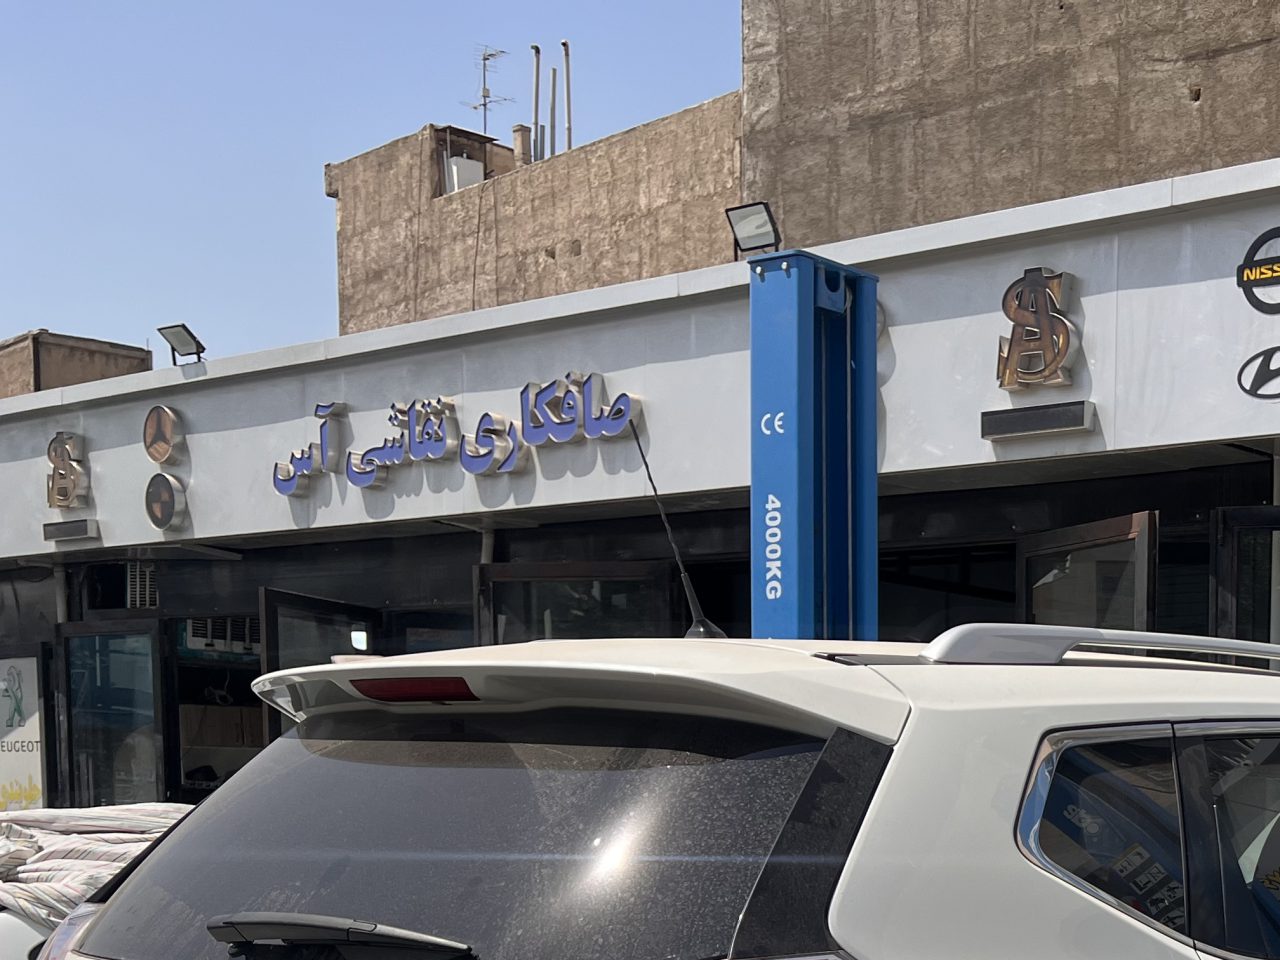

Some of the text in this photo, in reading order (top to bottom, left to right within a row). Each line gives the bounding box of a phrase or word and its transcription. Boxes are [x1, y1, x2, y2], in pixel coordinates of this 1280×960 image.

[273, 371, 634, 497] صافکاری نقاشی آس
[760, 411, 785, 435] CE
[765, 494, 782, 600] 4000KG
[0, 740, 42, 753] EUGEOT
